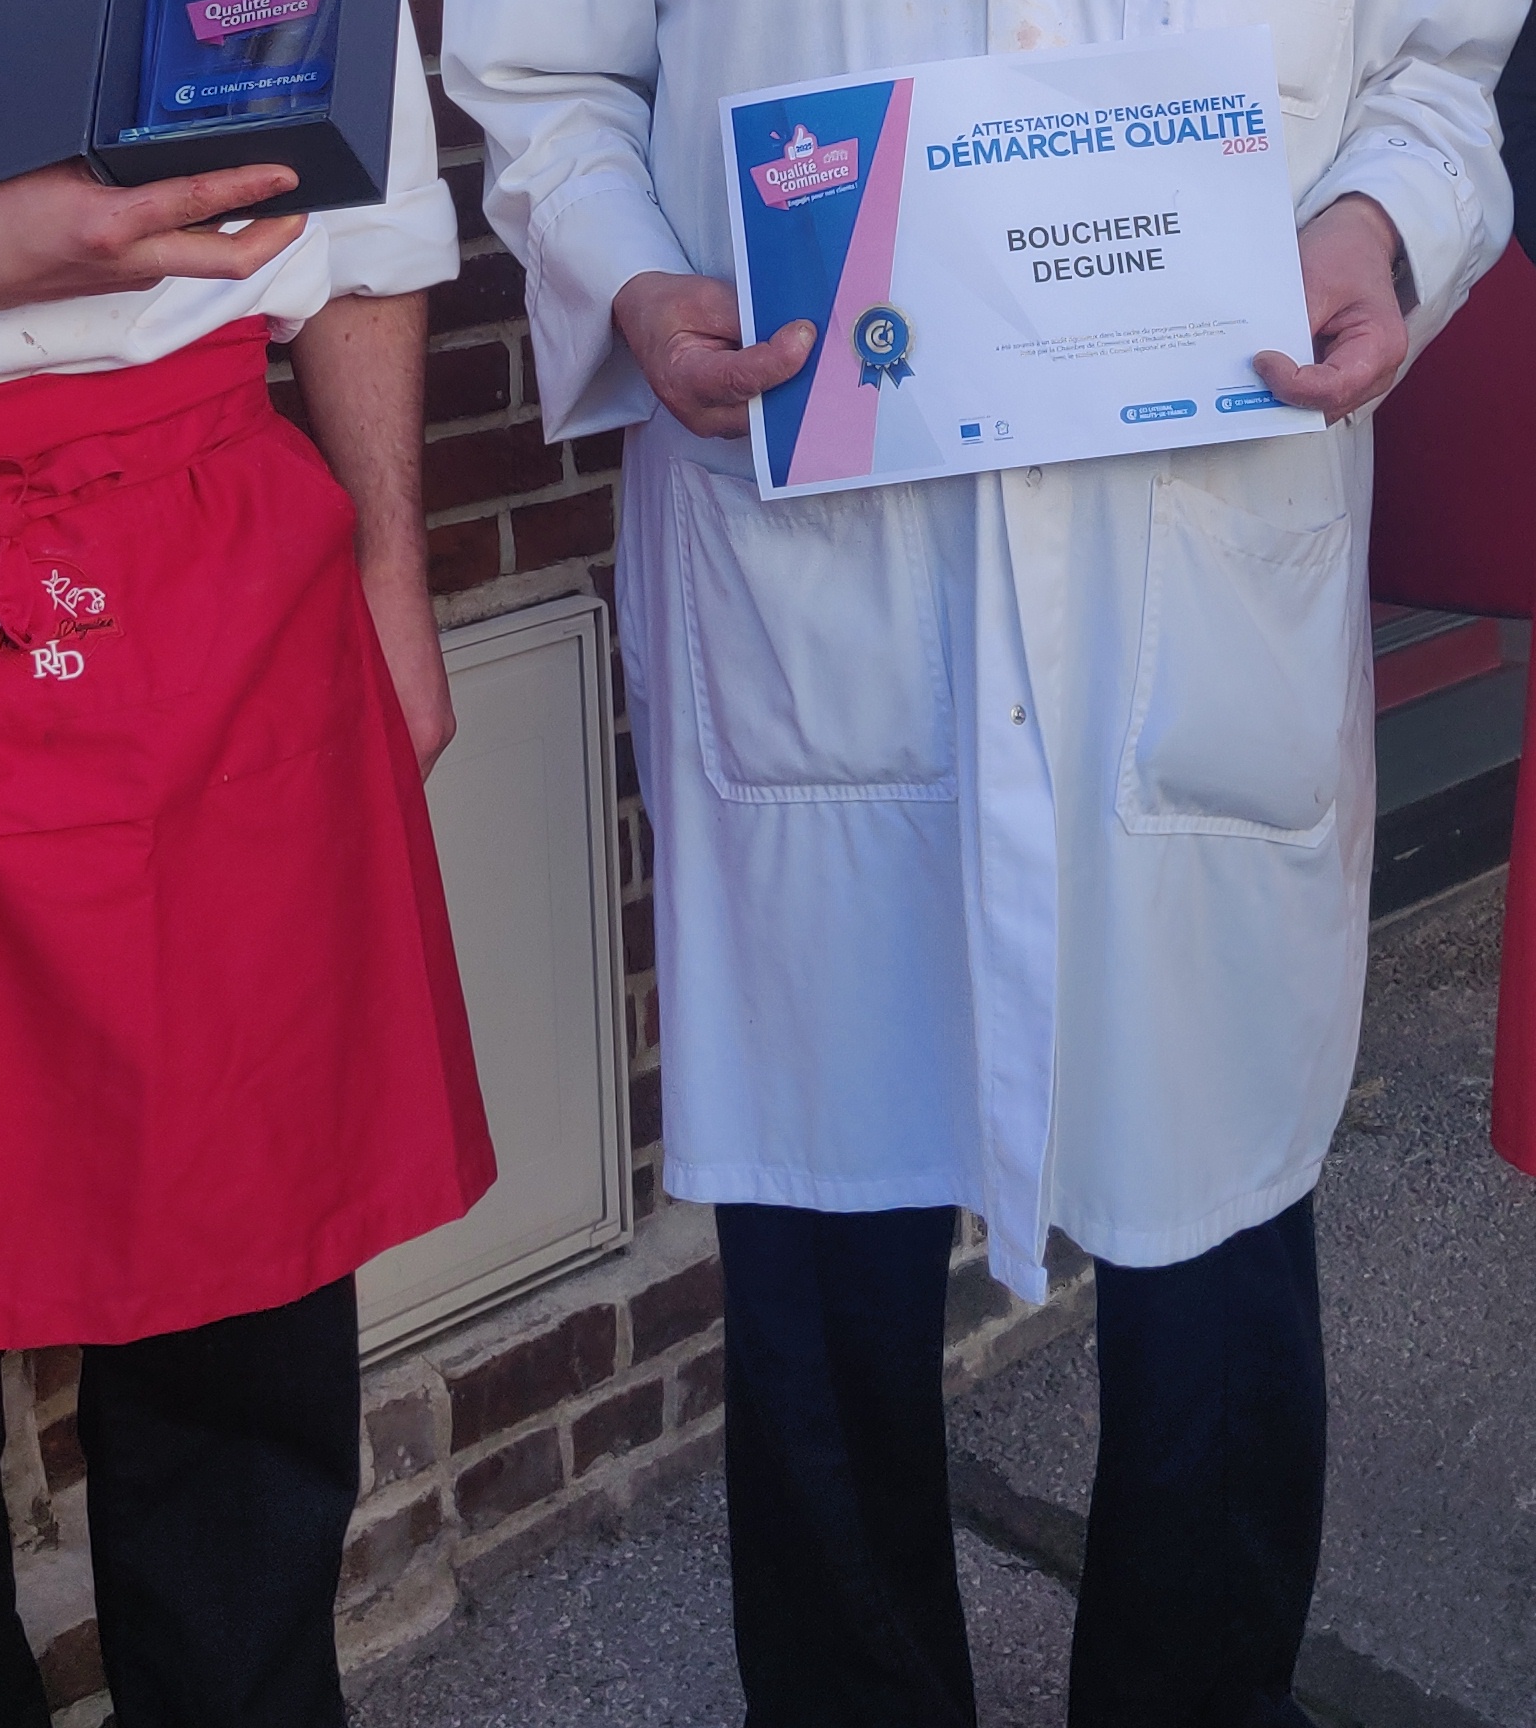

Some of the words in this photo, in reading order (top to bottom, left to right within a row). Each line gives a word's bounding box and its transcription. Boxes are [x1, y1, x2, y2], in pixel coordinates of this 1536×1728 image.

[221, 0, 309, 28] commerce
[200, 87, 219, 97] CCI
[220, 72, 318, 94] HAUTS-DE-FRANCE
[971, 111, 1090, 138] ATTESTATION
[1095, 94, 1247, 123] D'ENGAGEMENT
[926, 125, 1116, 172] DÉMARCHE
[1124, 102, 1267, 148] QUALITÉ
[1222, 135, 1269, 156] 2025
[766, 159, 818, 186] Qualité
[781, 165, 849, 193] commerce
[1006, 212, 1181, 252] BOUCHERIE
[1033, 248, 1166, 283] DEGUINE
